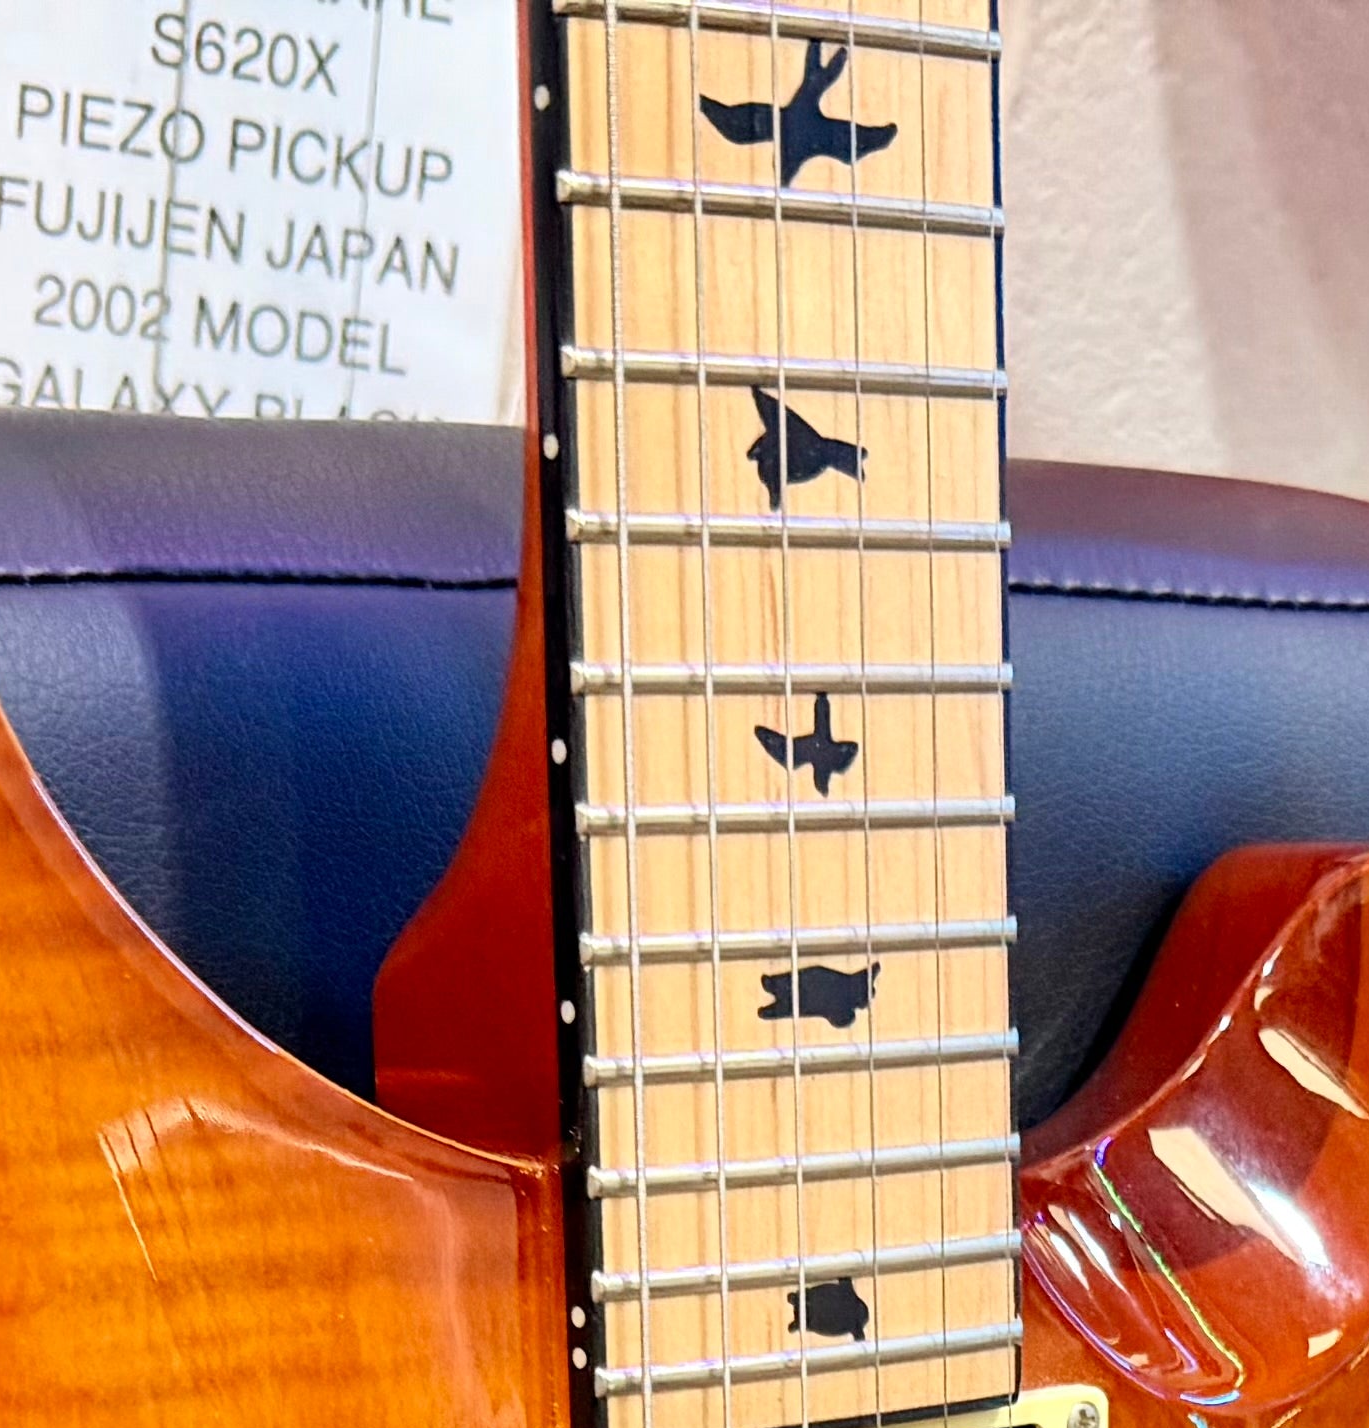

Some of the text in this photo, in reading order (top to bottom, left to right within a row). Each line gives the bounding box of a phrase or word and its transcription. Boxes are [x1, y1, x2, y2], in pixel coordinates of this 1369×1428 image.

[152, 12, 339, 97] S620X
[17, 83, 454, 202] PIEZO PICKUP
[266, 218, 460, 296] JAPAN
[34, 273, 407, 376] 2002 MODEL
